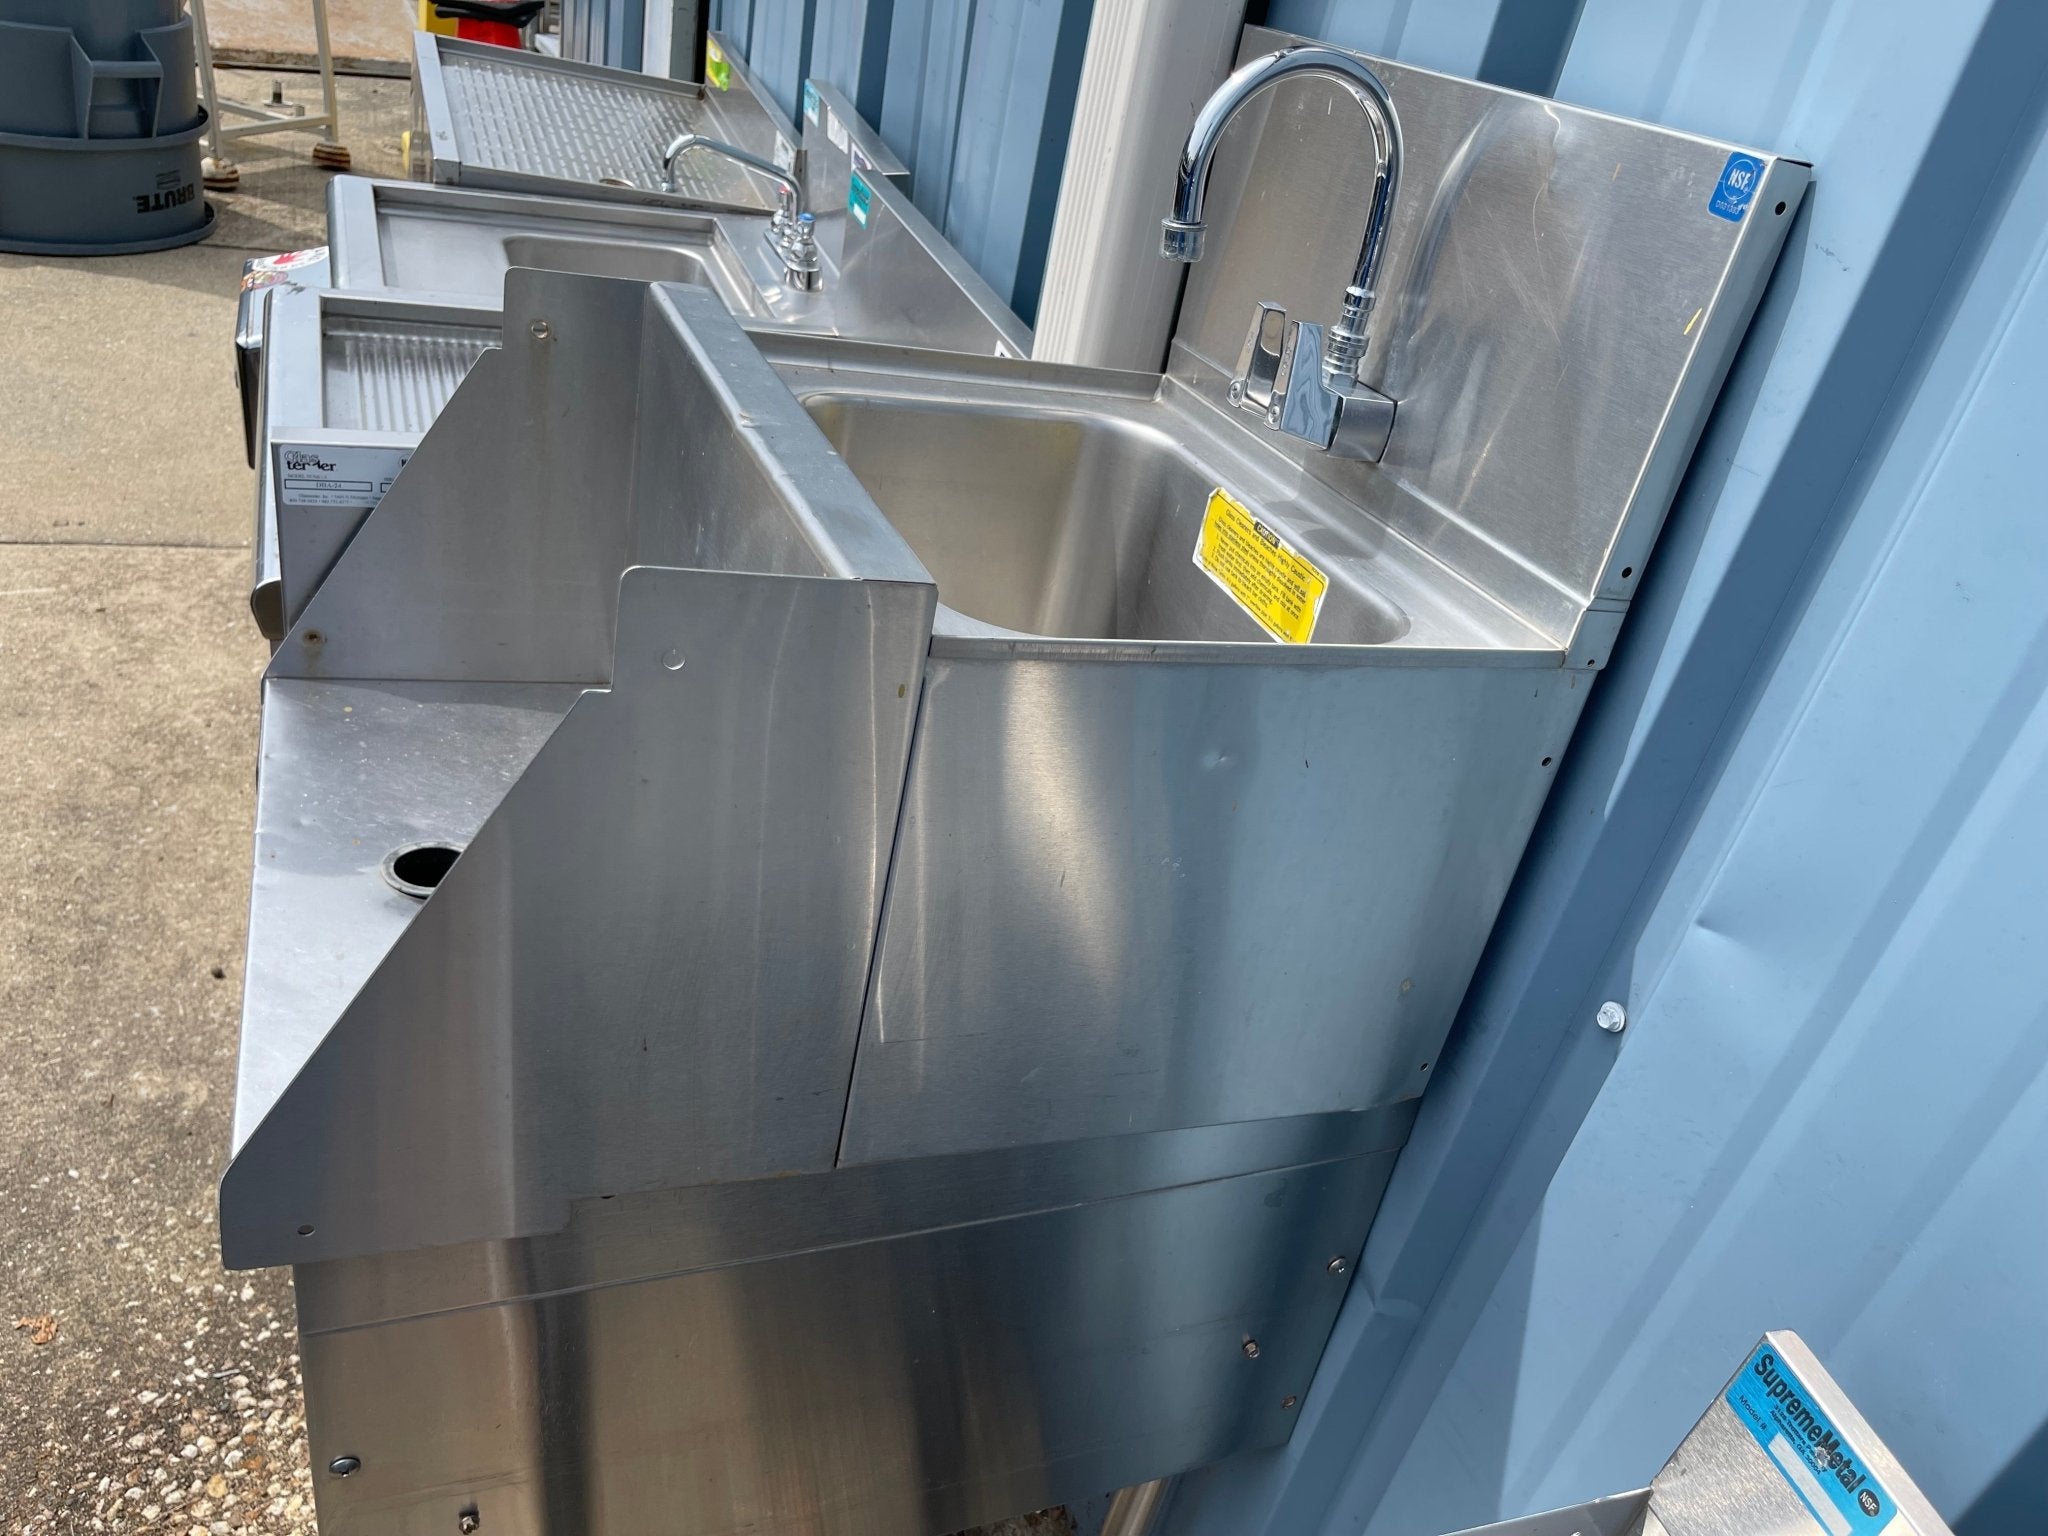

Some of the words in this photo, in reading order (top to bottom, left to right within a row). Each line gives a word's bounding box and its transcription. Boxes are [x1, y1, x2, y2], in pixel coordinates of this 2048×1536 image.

[1728, 168, 1751, 191] NSF
[136, 182, 196, 214] BRUTE
[1738, 1395, 1761, 1423] Model
[1859, 1492, 1878, 1511] NSF
